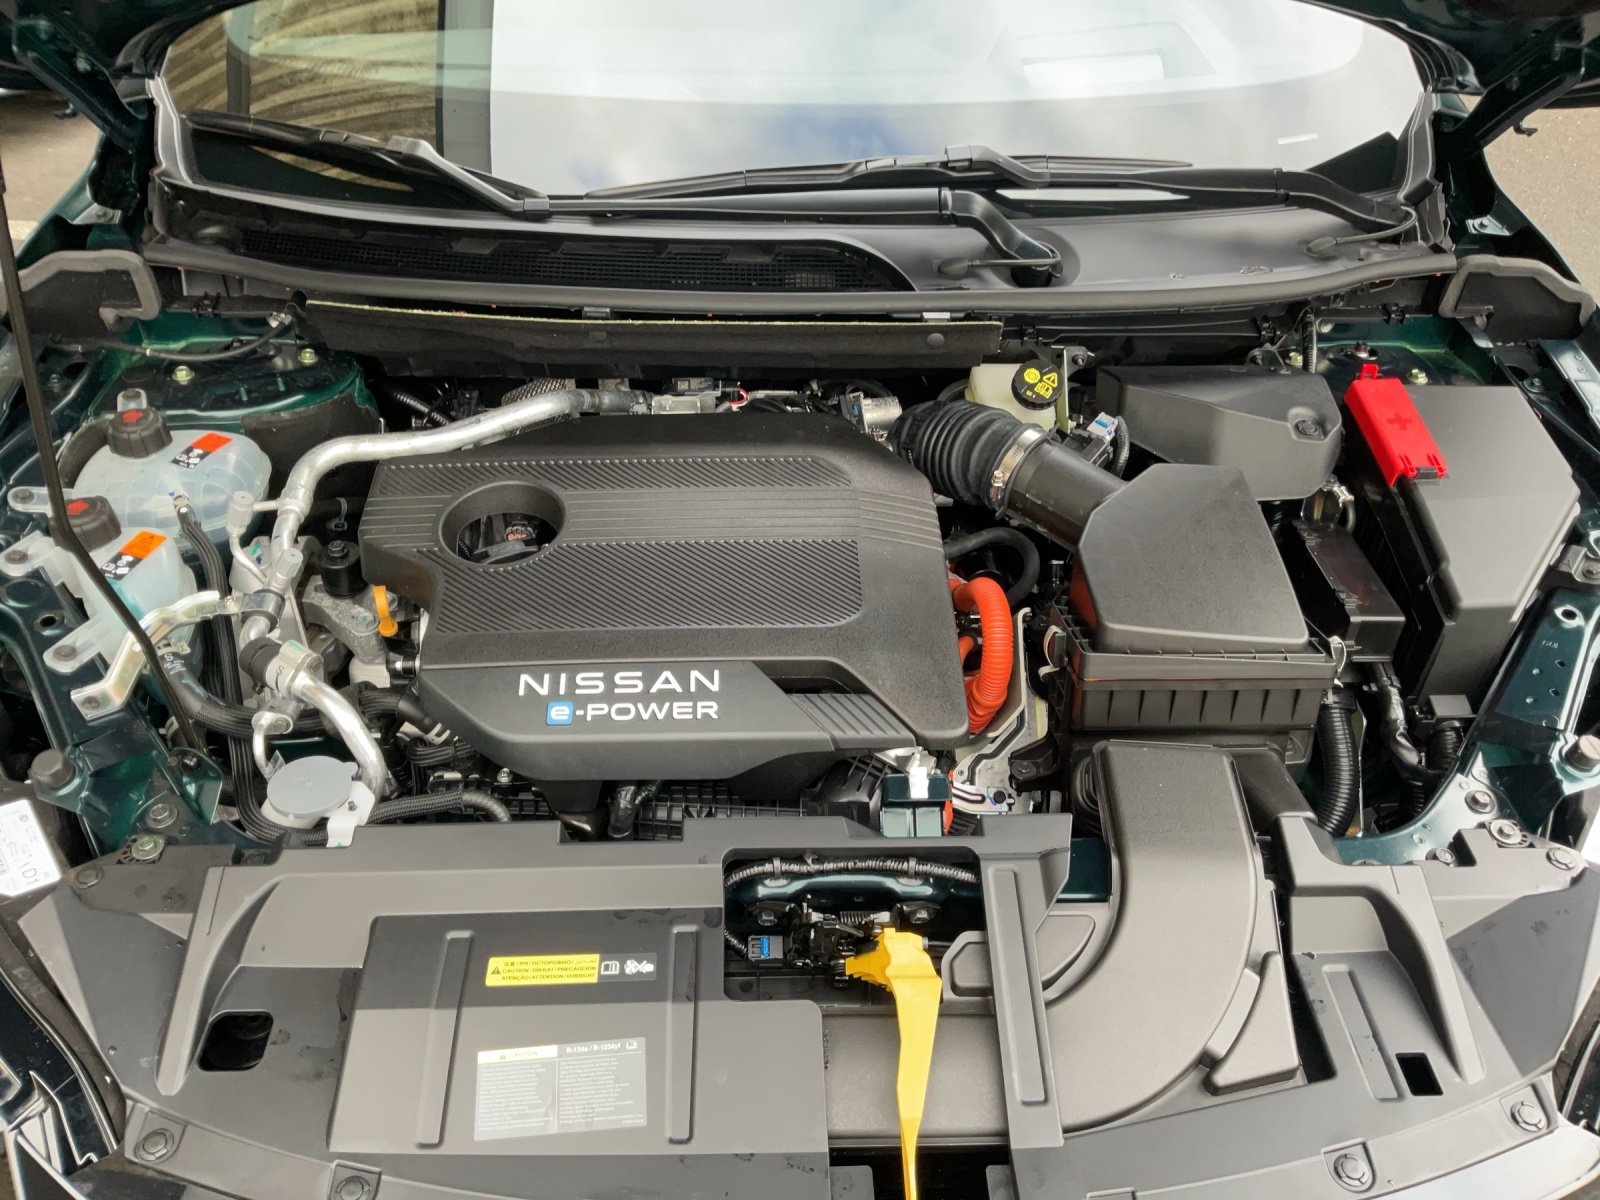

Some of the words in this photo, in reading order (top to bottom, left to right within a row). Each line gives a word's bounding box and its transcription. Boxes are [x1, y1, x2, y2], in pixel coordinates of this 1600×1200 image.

[518, 669, 719, 696] NISSAN
[548, 701, 719, 722] e-POWER
[509, 1050, 538, 1058] CAUTION
[593, 1042, 621, 1051] R-1234yf
